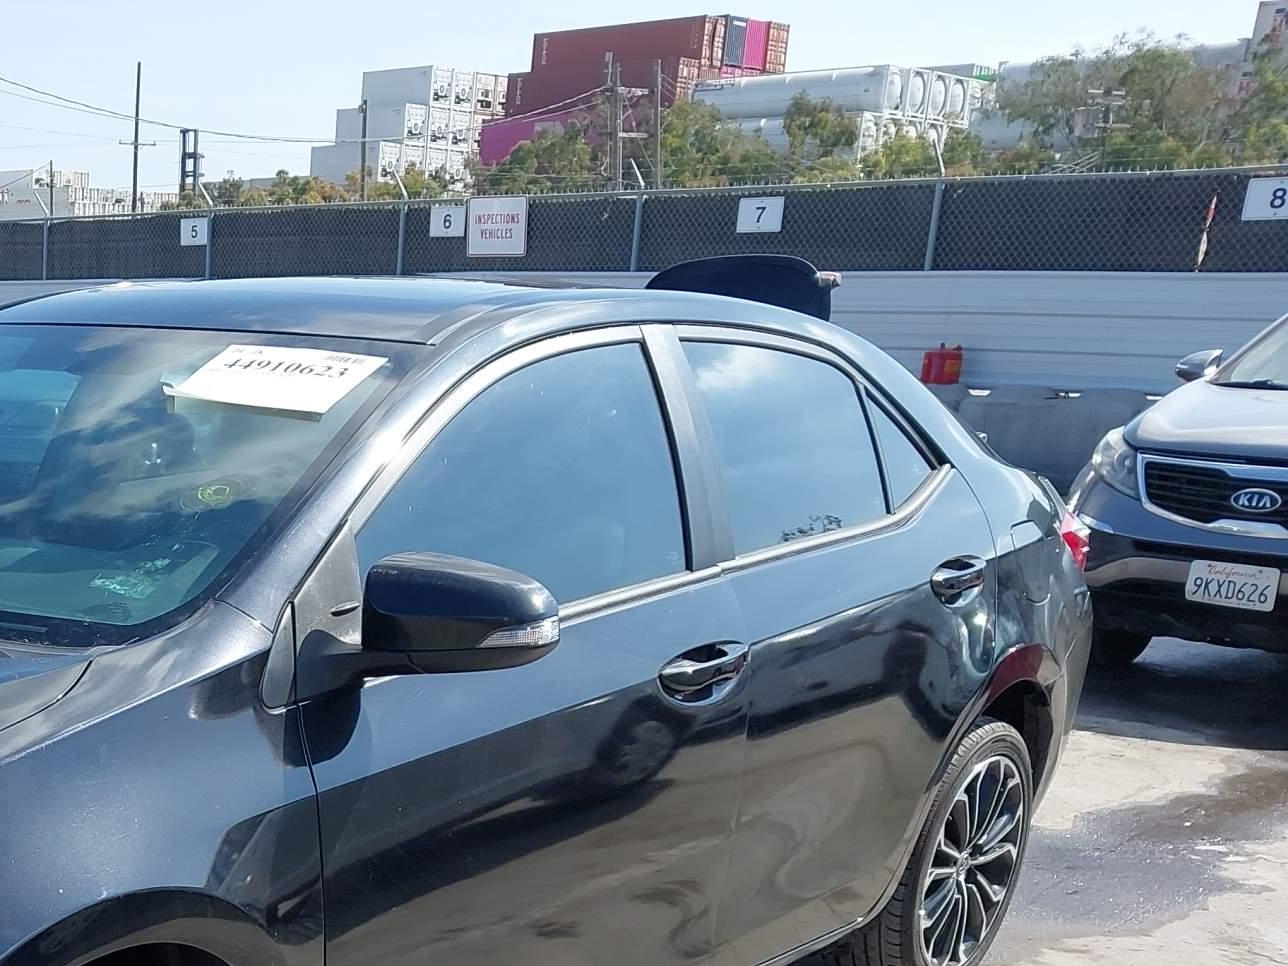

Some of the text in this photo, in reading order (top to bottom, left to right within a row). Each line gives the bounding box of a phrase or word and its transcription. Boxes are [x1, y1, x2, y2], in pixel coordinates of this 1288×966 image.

[1269, 187, 1288, 209] 8
[443, 213, 452, 230] 6
[474, 213, 521, 225] INSPECTIONS
[755, 206, 767, 223] 7
[191, 224, 199, 239] 5
[480, 228, 513, 240] VEHICLES
[223, 357, 349, 379] 44910623
[1238, 493, 1272, 508] KIA
[1207, 563, 1258, 580] California
[1192, 576, 1271, 604] 9KXD626
